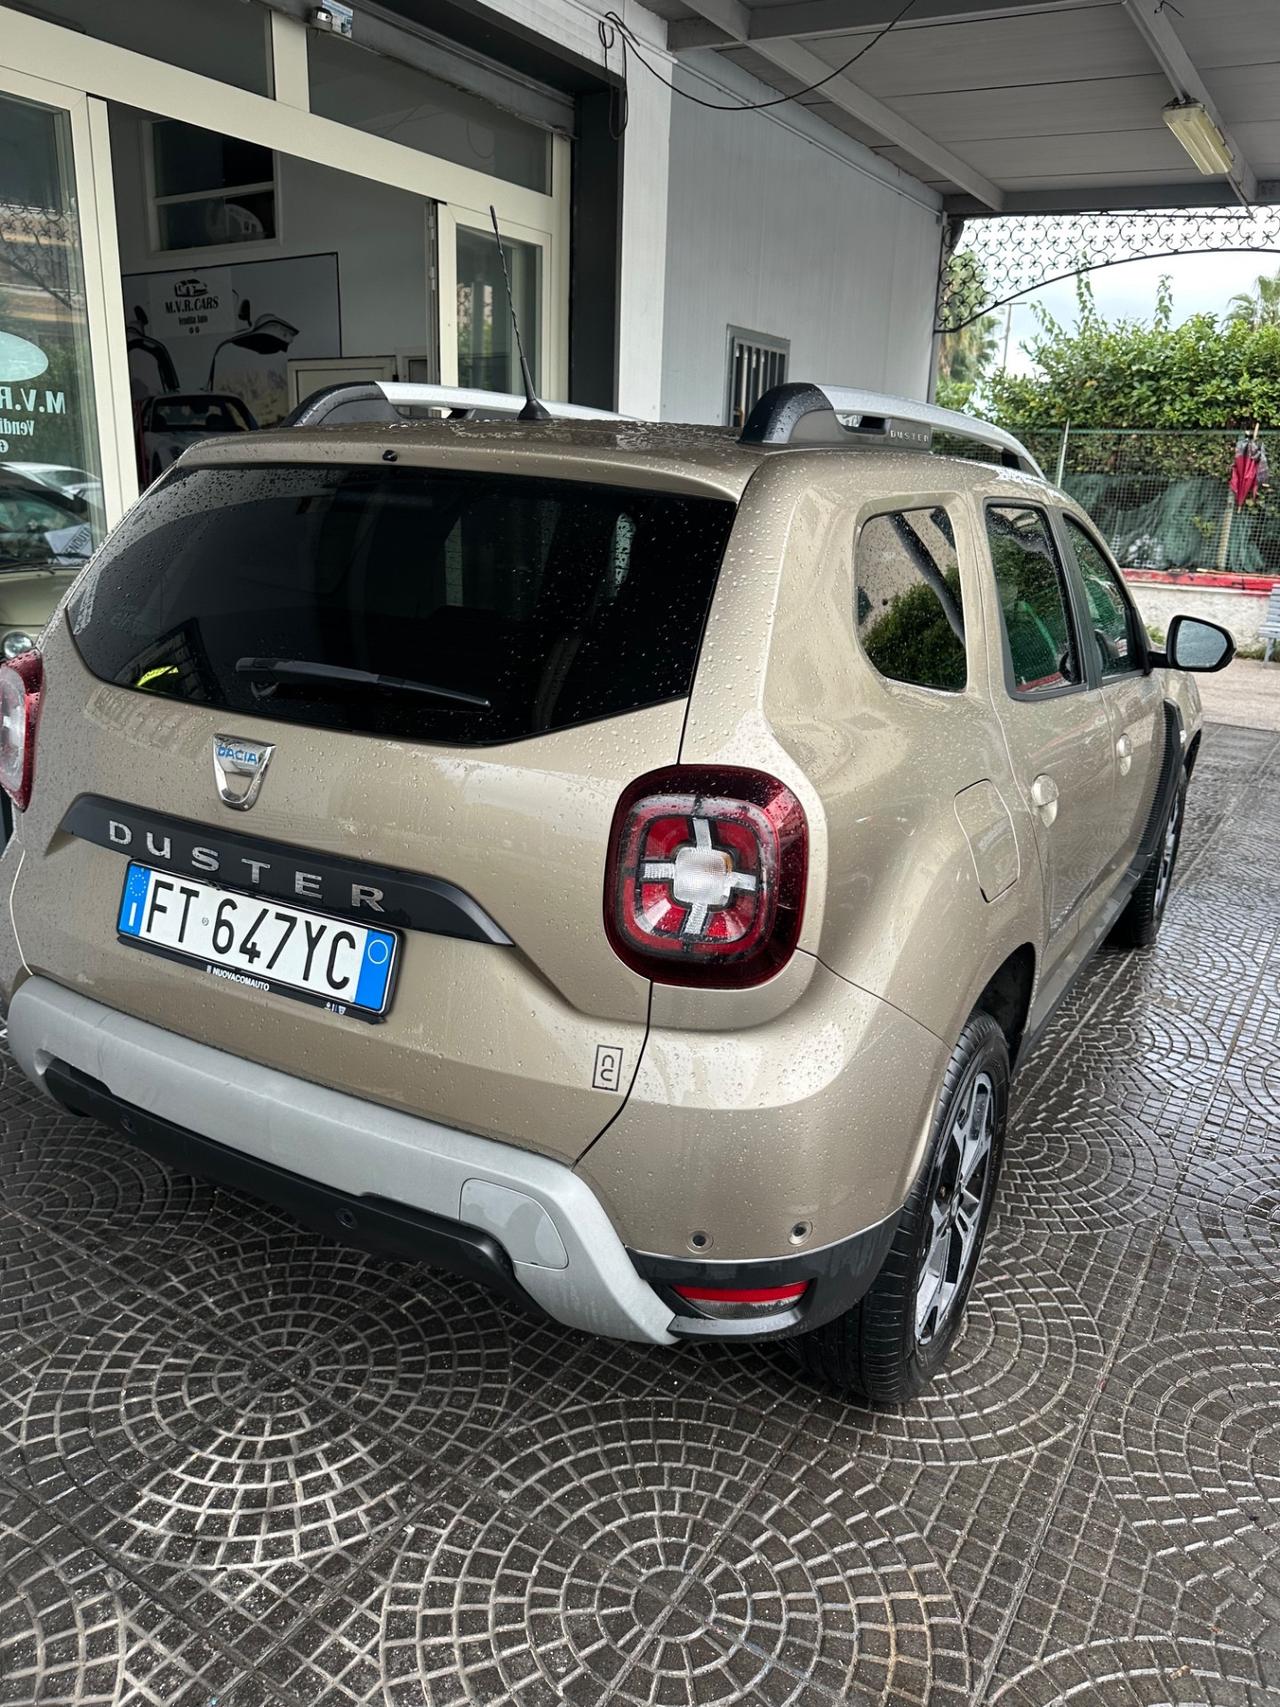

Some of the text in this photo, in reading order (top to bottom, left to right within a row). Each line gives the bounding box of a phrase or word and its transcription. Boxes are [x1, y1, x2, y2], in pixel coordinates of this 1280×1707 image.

[165, 296, 219, 313] M.V.R.CARS
[217, 746, 258, 765] DACIA
[109, 820, 385, 912] DUSTER
[212, 967, 270, 992] NUOVACOMAUTO
